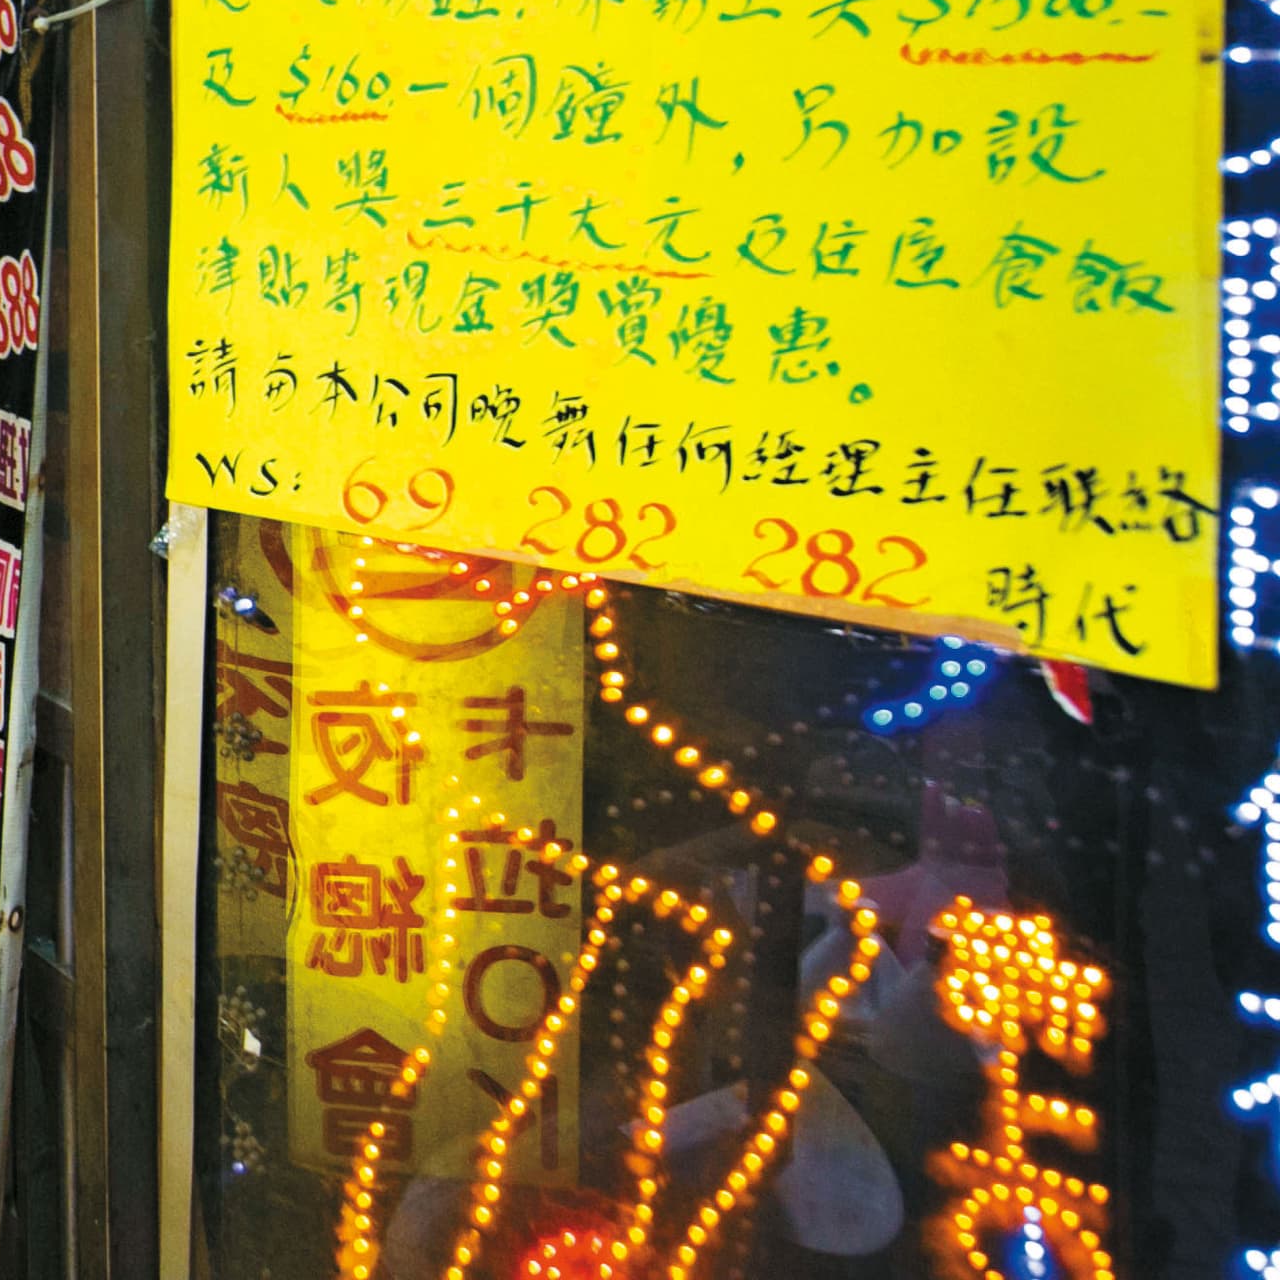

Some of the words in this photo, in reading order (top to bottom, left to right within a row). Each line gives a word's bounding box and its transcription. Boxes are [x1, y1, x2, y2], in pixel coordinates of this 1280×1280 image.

[343, 457, 455, 532] 69
[519, 485, 677, 570] 282
[742, 517, 931, 609] 282
